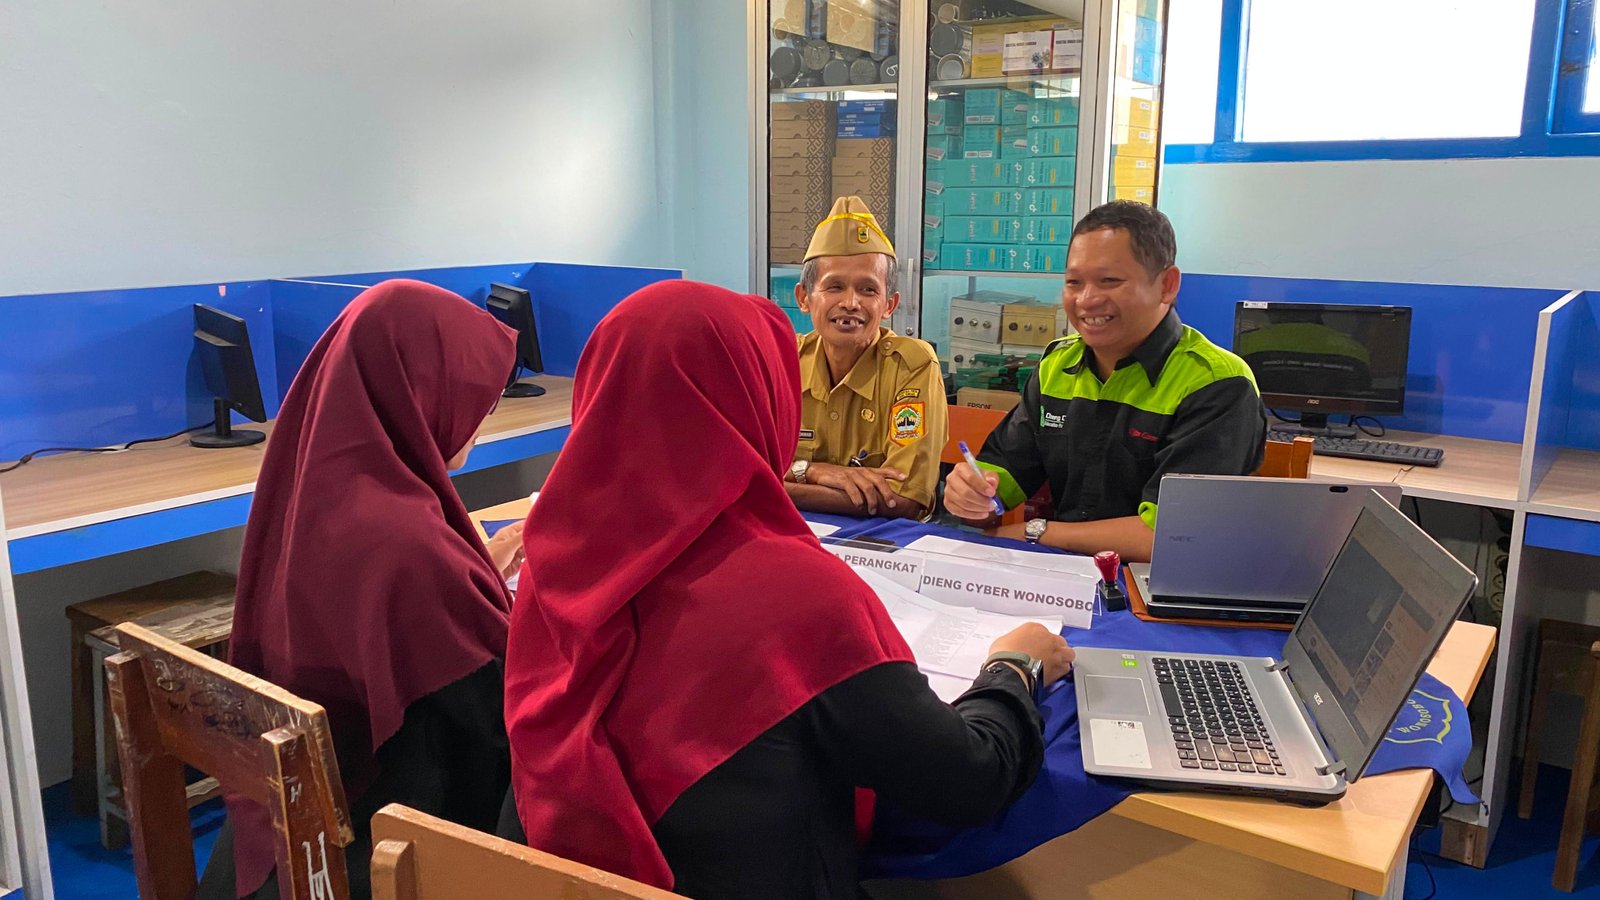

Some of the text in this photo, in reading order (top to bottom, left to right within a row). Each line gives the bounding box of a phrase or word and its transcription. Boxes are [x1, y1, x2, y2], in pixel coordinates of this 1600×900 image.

[844, 554, 917, 574] PERANGKAT
[923, 575, 962, 590] DIENG
[966, 582, 1010, 598] CYBER
